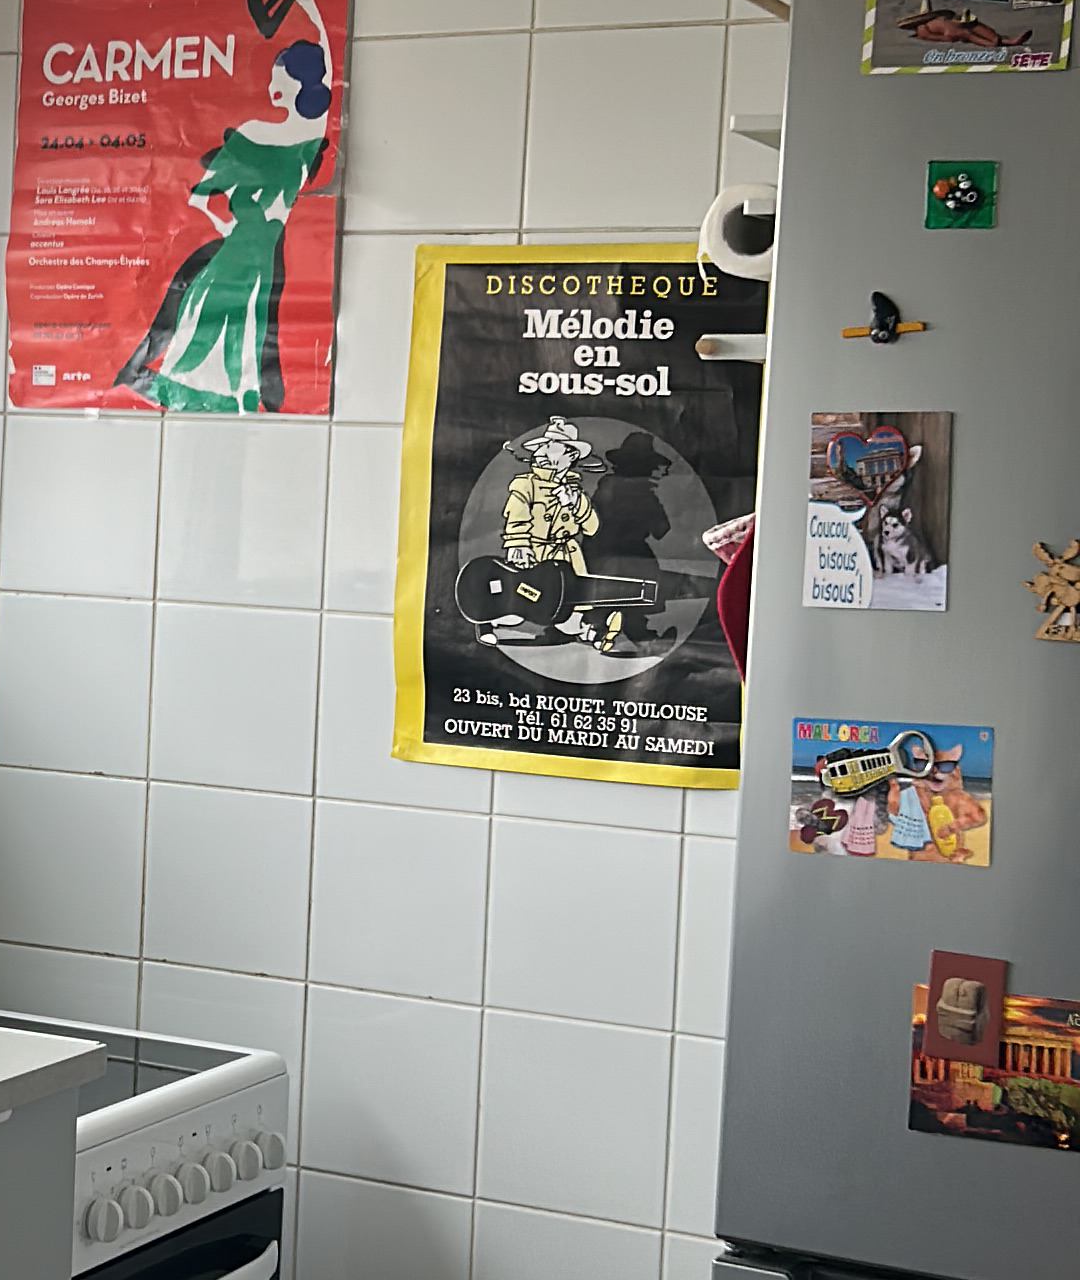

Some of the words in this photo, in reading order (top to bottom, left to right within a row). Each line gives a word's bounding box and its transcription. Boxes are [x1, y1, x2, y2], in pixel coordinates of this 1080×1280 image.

[43, 34, 235, 85] CARMEN
[42, 91, 105, 110] Georges
[109, 88, 147, 105] Bizet
[41, 135, 84, 150] 24.04
[100, 133, 146, 148] 04.05
[29, 256, 67, 266] Orchestre
[70, 257, 83, 266] des
[486, 275, 718, 297] DISCOTHEQUE
[522, 308, 675, 340] Mélodie
[573, 344, 620, 368] en
[63, 371, 91, 381] arte
[519, 367, 671, 396] sous-sol
[810, 515, 851, 542] Coucou,
[819, 546, 859, 576] bisous,
[453, 688, 471, 703] 23
[476, 690, 504, 708] bis,
[509, 693, 531, 709] bd
[536, 695, 606, 715] RIQUET.
[612, 700, 708, 722] TOULOUSE
[516, 709, 544, 727] Tél.
[550, 713, 568, 728] 61
[573, 715, 592, 730] 62
[597, 716, 616, 732] 35
[620, 718, 638, 734] 91
[798, 722, 879, 743] MALLORCA
[444, 719, 512, 739] OUVERT
[518, 725, 543, 741] DU
[548, 728, 608, 748] MARDI
[614, 734, 640, 751] AU
[645, 737, 715, 756] SAMEDI
